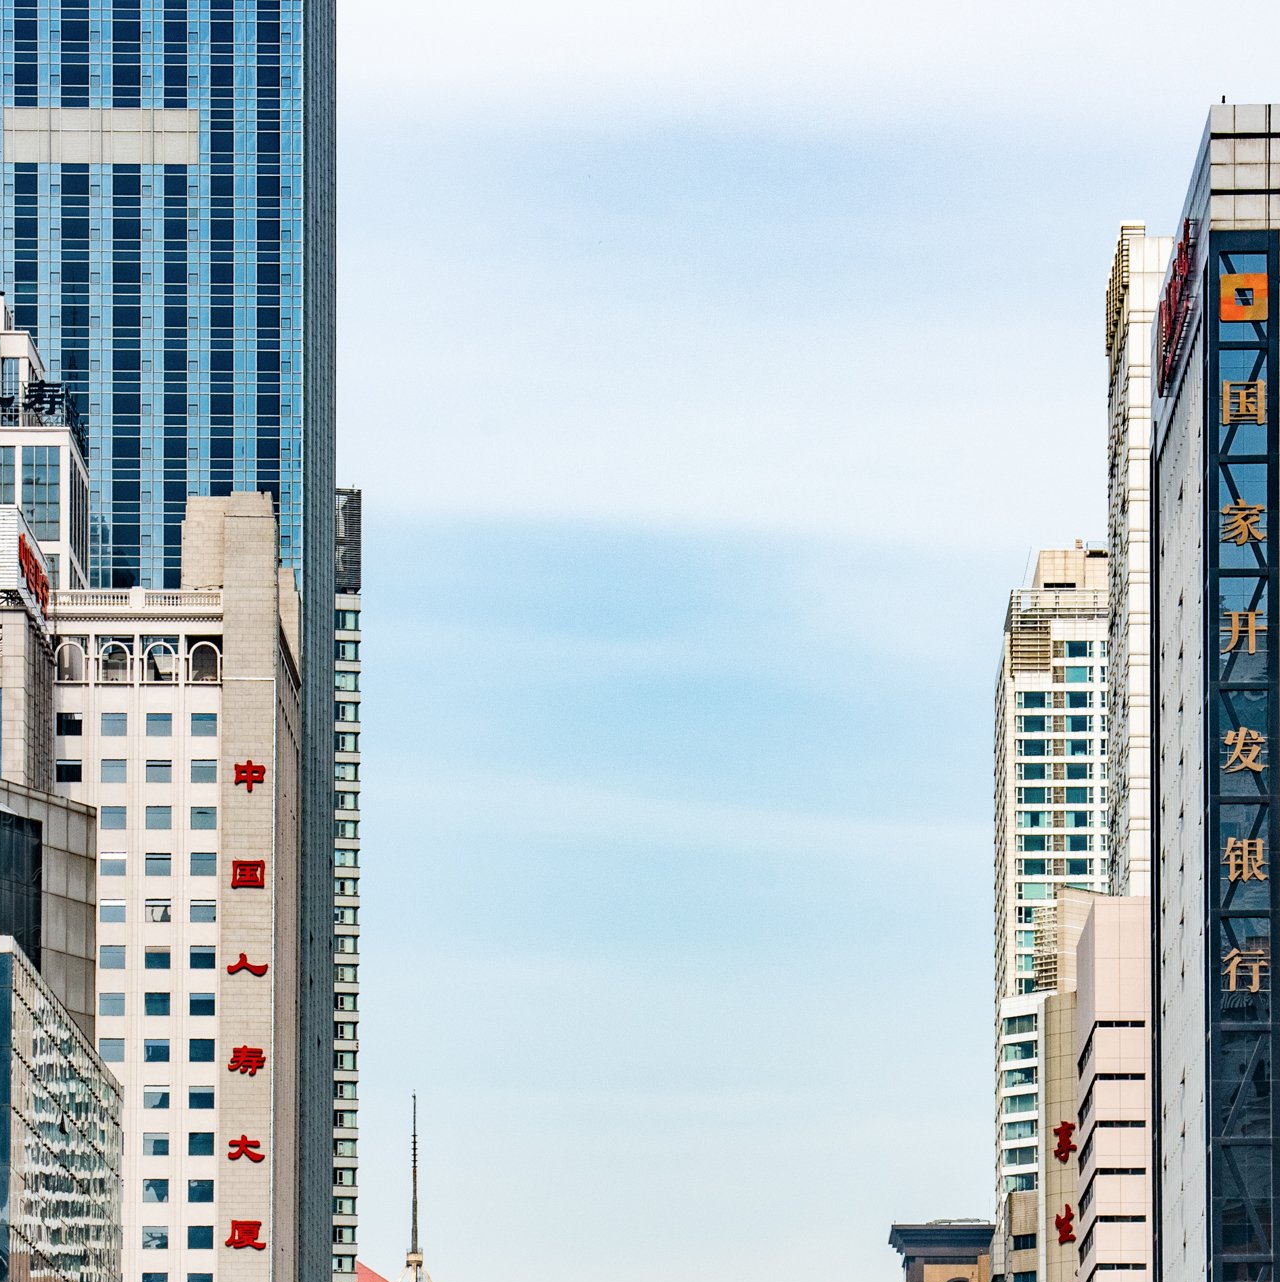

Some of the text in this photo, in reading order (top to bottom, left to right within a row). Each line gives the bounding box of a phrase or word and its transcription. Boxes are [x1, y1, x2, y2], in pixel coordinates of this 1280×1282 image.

[1221, 379, 1268, 993] 国家开发银行
[226, 760, 269, 1250] 中国人寿大厦
